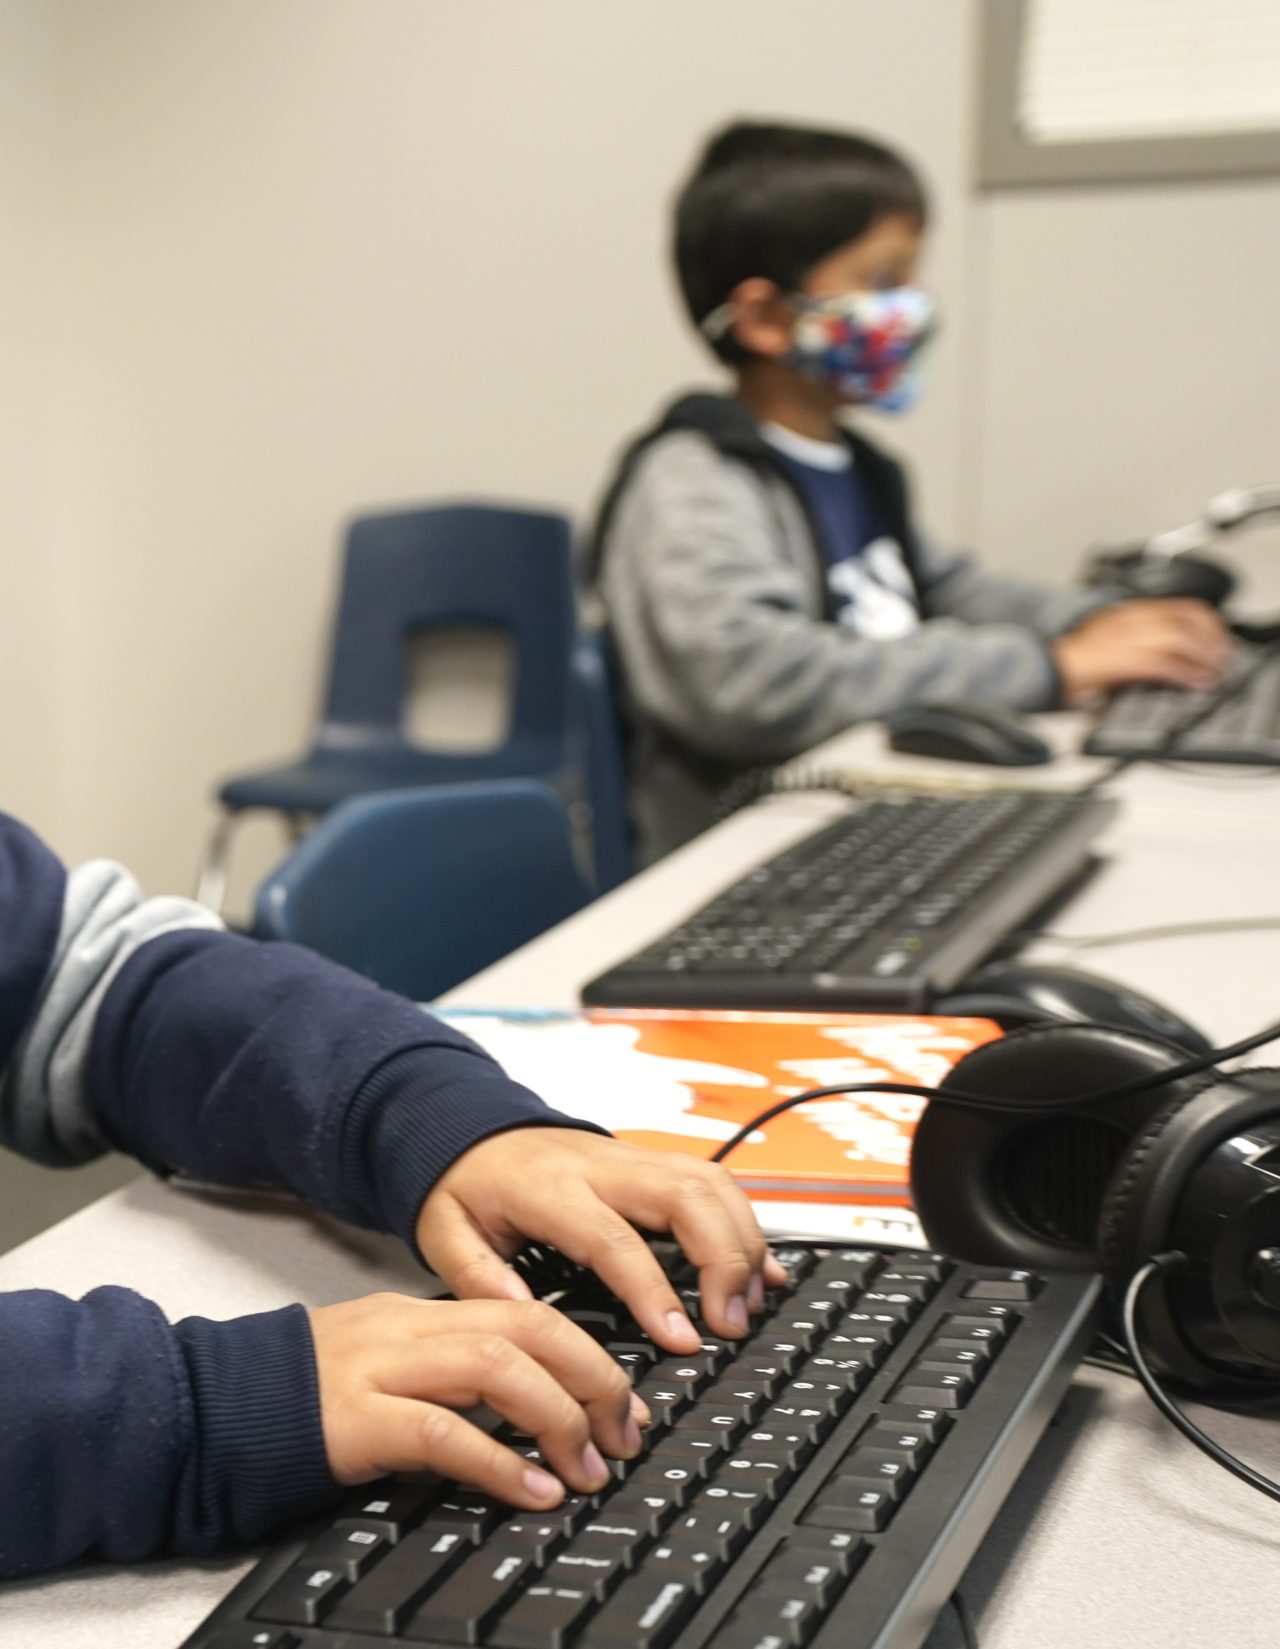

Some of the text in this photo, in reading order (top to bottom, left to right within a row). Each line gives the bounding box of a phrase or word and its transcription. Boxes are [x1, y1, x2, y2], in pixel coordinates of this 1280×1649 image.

[808, 1300, 833, 1312] W
[772, 1343, 797, 1353] R
[652, 1391, 677, 1402] H
[710, 1416, 735, 1426] U
[751, 1432, 774, 1442] 8
[664, 1469, 688, 1481] O
[705, 1487, 729, 1498] 0
[643, 1497, 666, 1509] P
